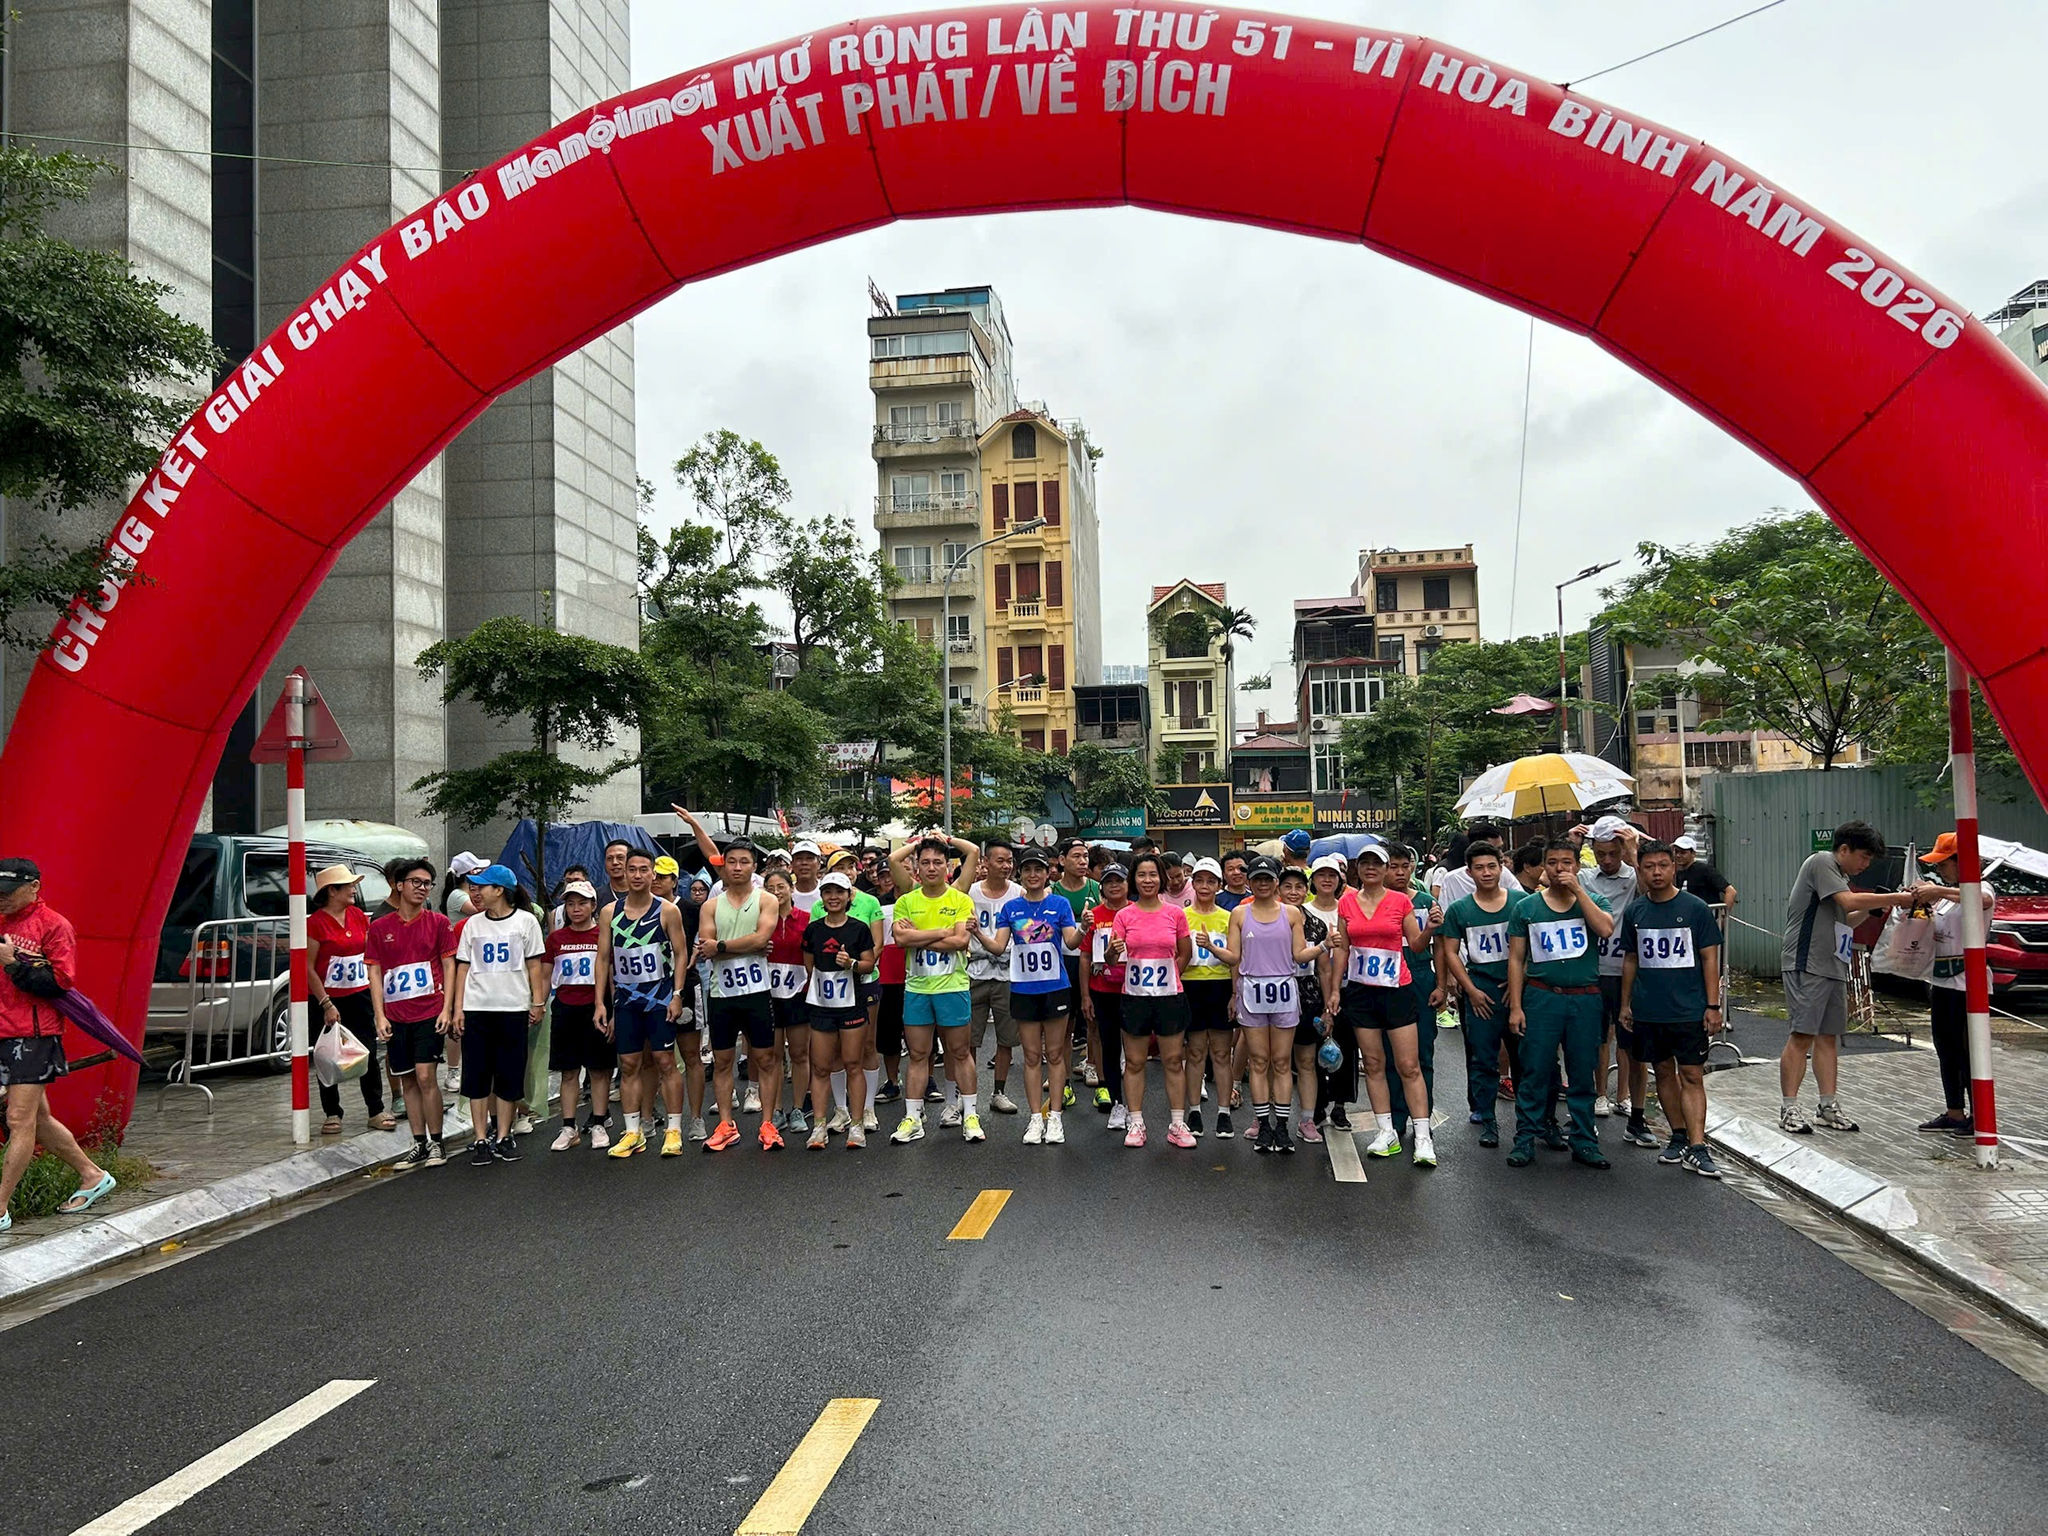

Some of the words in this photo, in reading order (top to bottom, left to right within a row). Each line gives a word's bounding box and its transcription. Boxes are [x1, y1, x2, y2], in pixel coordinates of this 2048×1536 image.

[701, 86, 826, 175] XUẤT
[1015, 48, 1078, 115] VỀ
[1103, 51, 1232, 116] ĐÍCH
[142, 425, 208, 518] KẾT
[205, 344, 285, 434] GIẢI
[287, 244, 389, 351] CHẠY
[399, 182, 490, 261] BÁO
[733, 35, 814, 100] MỞ
[829, 21, 968, 75] RỘNG
[1112, 9, 1220, 51] THỨ
[1232, 20, 1293, 60] 51
[1353, 36, 1405, 78] VÌ
[1418, 51, 1529, 117] HÒA
[1547, 98, 1690, 178] BÌNH
[1691, 160, 1826, 258] NĂM
[1826, 247, 1966, 349] 2026
[1317, 809, 1352, 822] NINH
[1815, 830, 1833, 839] VAY
[1540, 926, 1586, 953] 415
[1643, 936, 1686, 959] 394
[482, 942, 511, 964] 85
[619, 952, 657, 976] 359
[1019, 950, 1053, 973] 199
[331, 960, 365, 982] 330
[562, 957, 591, 977] 88
[722, 963, 763, 989] 356
[1129, 965, 1168, 987] 322
[1357, 954, 1396, 979] 184
[386, 967, 428, 995] 329
[816, 977, 849, 1000] 197
[1252, 980, 1291, 1004] 190
